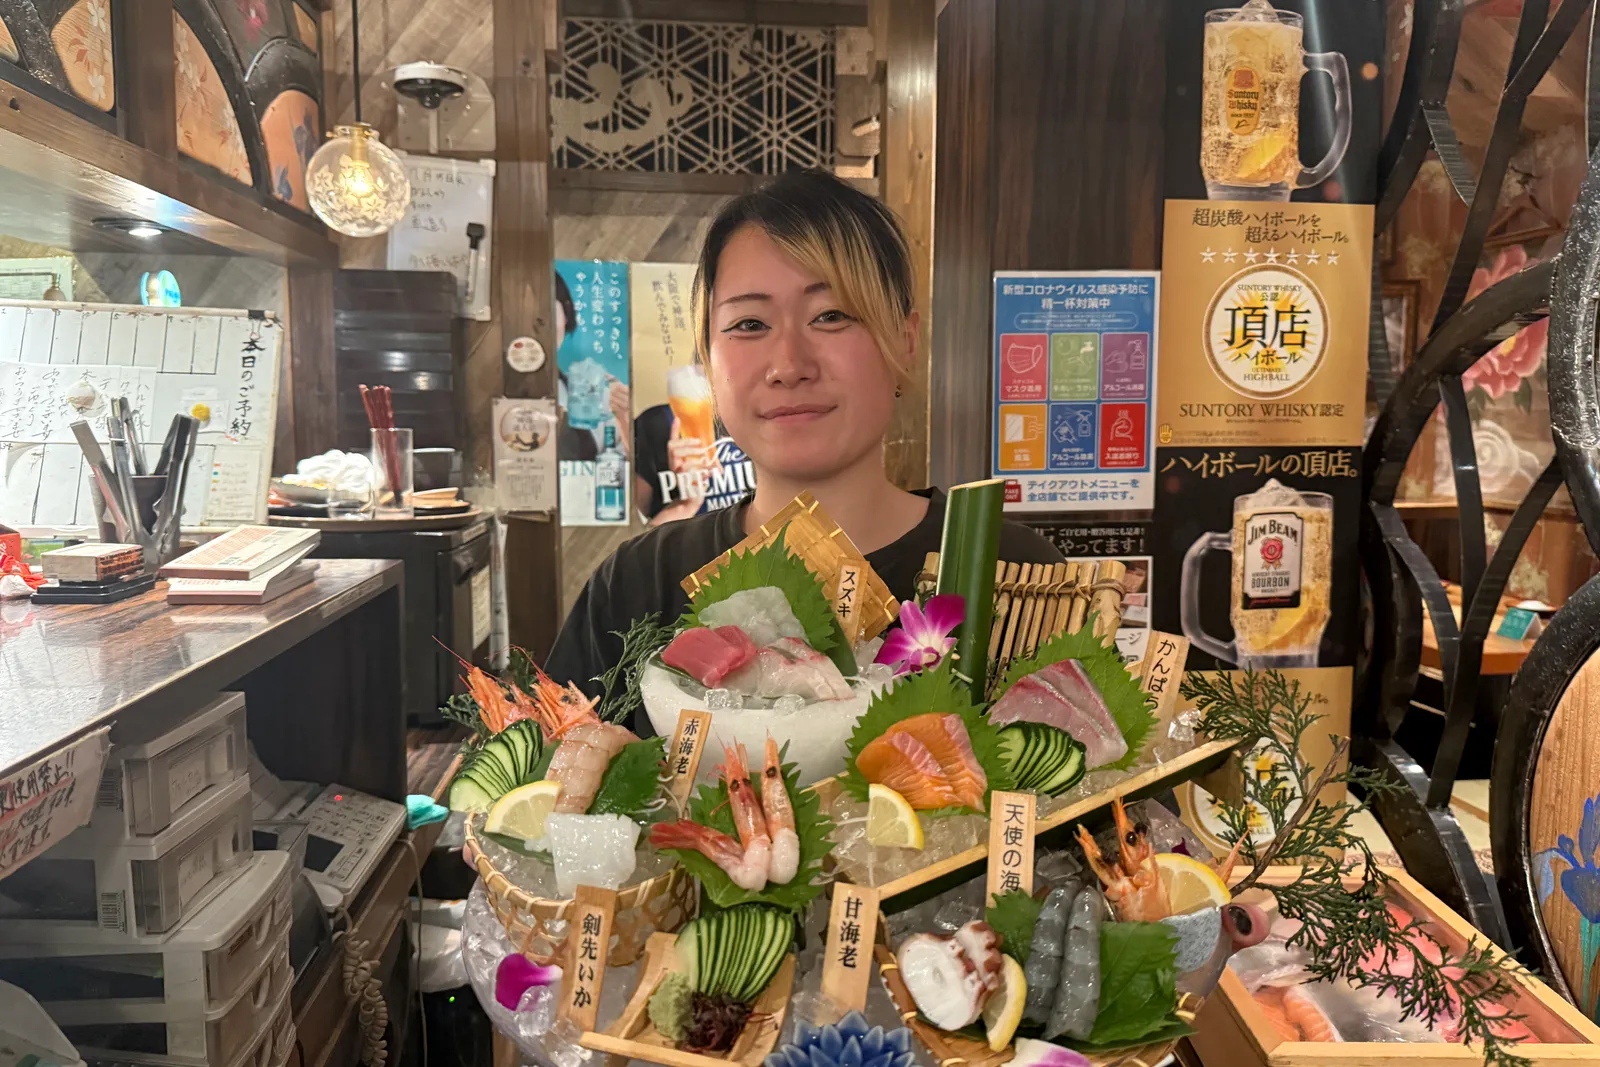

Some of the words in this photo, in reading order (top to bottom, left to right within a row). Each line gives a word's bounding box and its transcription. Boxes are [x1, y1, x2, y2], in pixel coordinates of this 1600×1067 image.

[1227, 90, 1259, 101] Suntory
[1228, 100, 1258, 111] Whisky
[1192, 208, 1321, 228] 超炭酸ハイボールを
[1244, 226, 1349, 244] 超えるハイボール。
[1003, 284, 1149, 296] 新型コロナウイルス感染予防に
[1237, 284, 1272, 292] SUNTORY
[1274, 284, 1303, 292] WHISKY
[1260, 292, 1280, 302] 公認
[574, 271, 587, 333] やうかも。
[1041, 298, 1111, 309] 精一杯対策中
[608, 271, 623, 360] このすっきり、
[1223, 304, 1312, 349] 頂店
[1231, 350, 1302, 366] ハイボール
[1243, 373, 1291, 381] HIGHBALL
[229, 338, 267, 437] 本日のご予約
[1179, 403, 1258, 418] SUNTORY
[1160, 450, 1359, 479] ハイボールの頂店。
[1027, 478, 1140, 489] テイクアウトメニューを
[1027, 491, 1134, 502] 全店舗でご提供中です。
[1248, 524, 1266, 544] JIM
[1269, 520, 1298, 543] BEAM
[1251, 577, 1290, 589] BOURBON
[836, 570, 857, 618] スズキ
[675, 718, 700, 775] 赤海老
[999, 803, 1025, 891] 天使の海
[837, 896, 863, 969] 甘海老
[572, 912, 602, 1009] 剣先いか
